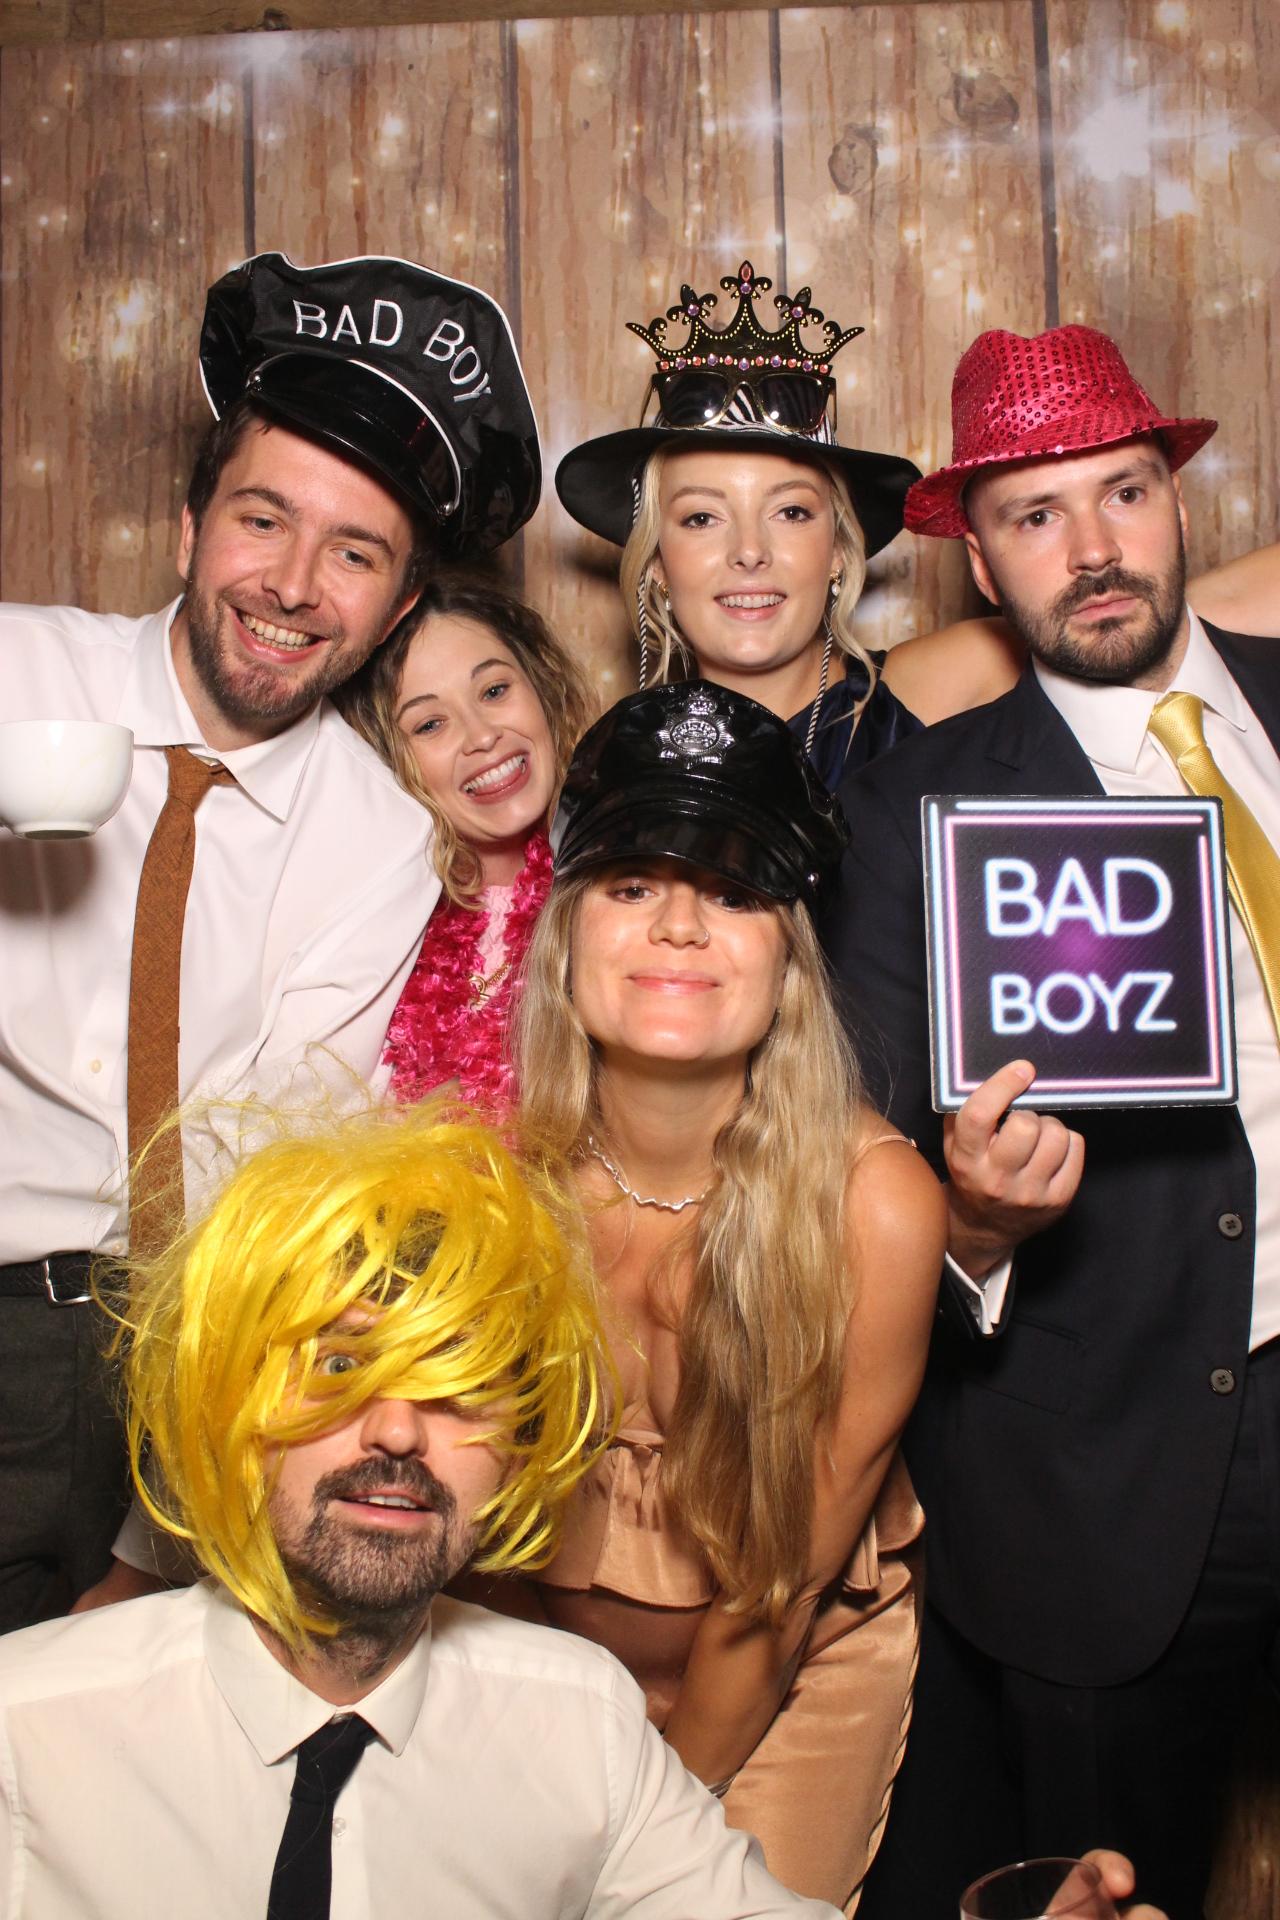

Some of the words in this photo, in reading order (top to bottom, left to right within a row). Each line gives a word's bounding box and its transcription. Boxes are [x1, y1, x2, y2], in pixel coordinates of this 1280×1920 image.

[292, 299, 404, 347] BAD
[422, 318, 492, 402] BOY
[984, 857, 1173, 936] BAD
[991, 971, 1179, 1035] BOYZ
